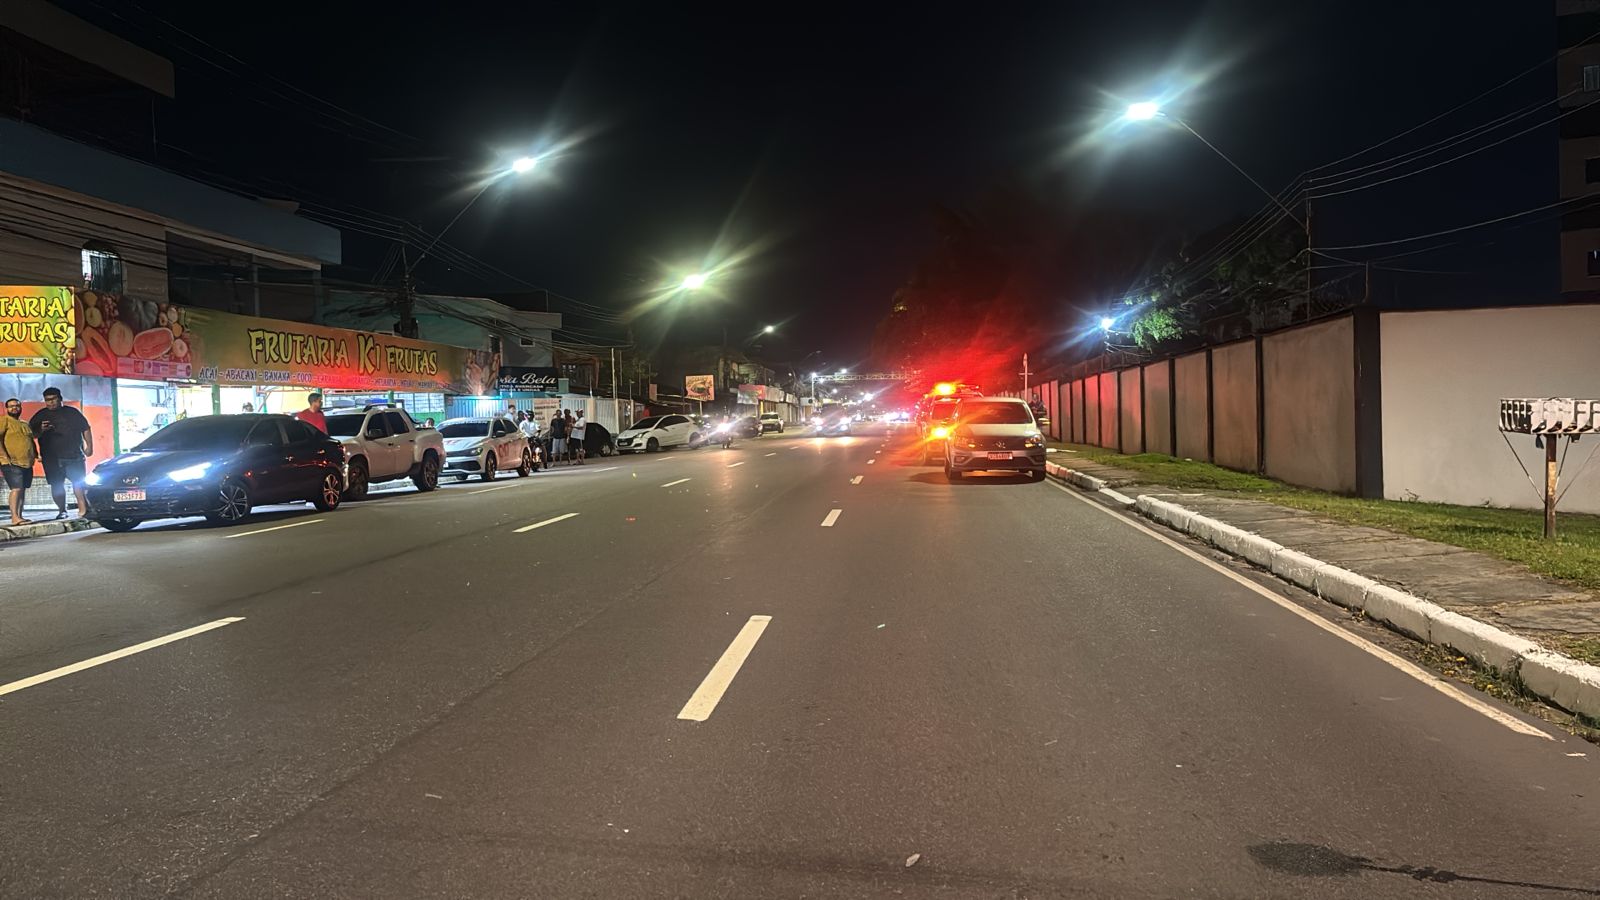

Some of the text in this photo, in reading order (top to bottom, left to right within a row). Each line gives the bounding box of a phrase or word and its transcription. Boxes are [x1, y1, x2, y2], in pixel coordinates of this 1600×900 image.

[0, 296, 65, 318] TARIA
[0, 322, 69, 343] RUTAS
[247, 328, 350, 369] FRUTARIA
[385, 345, 438, 376] FRUTAS
[225, 368, 257, 381] ABACAXI
[264, 369, 291, 382] BANANA
[297, 371, 312, 383] COCO
[520, 373, 557, 384] Bela
